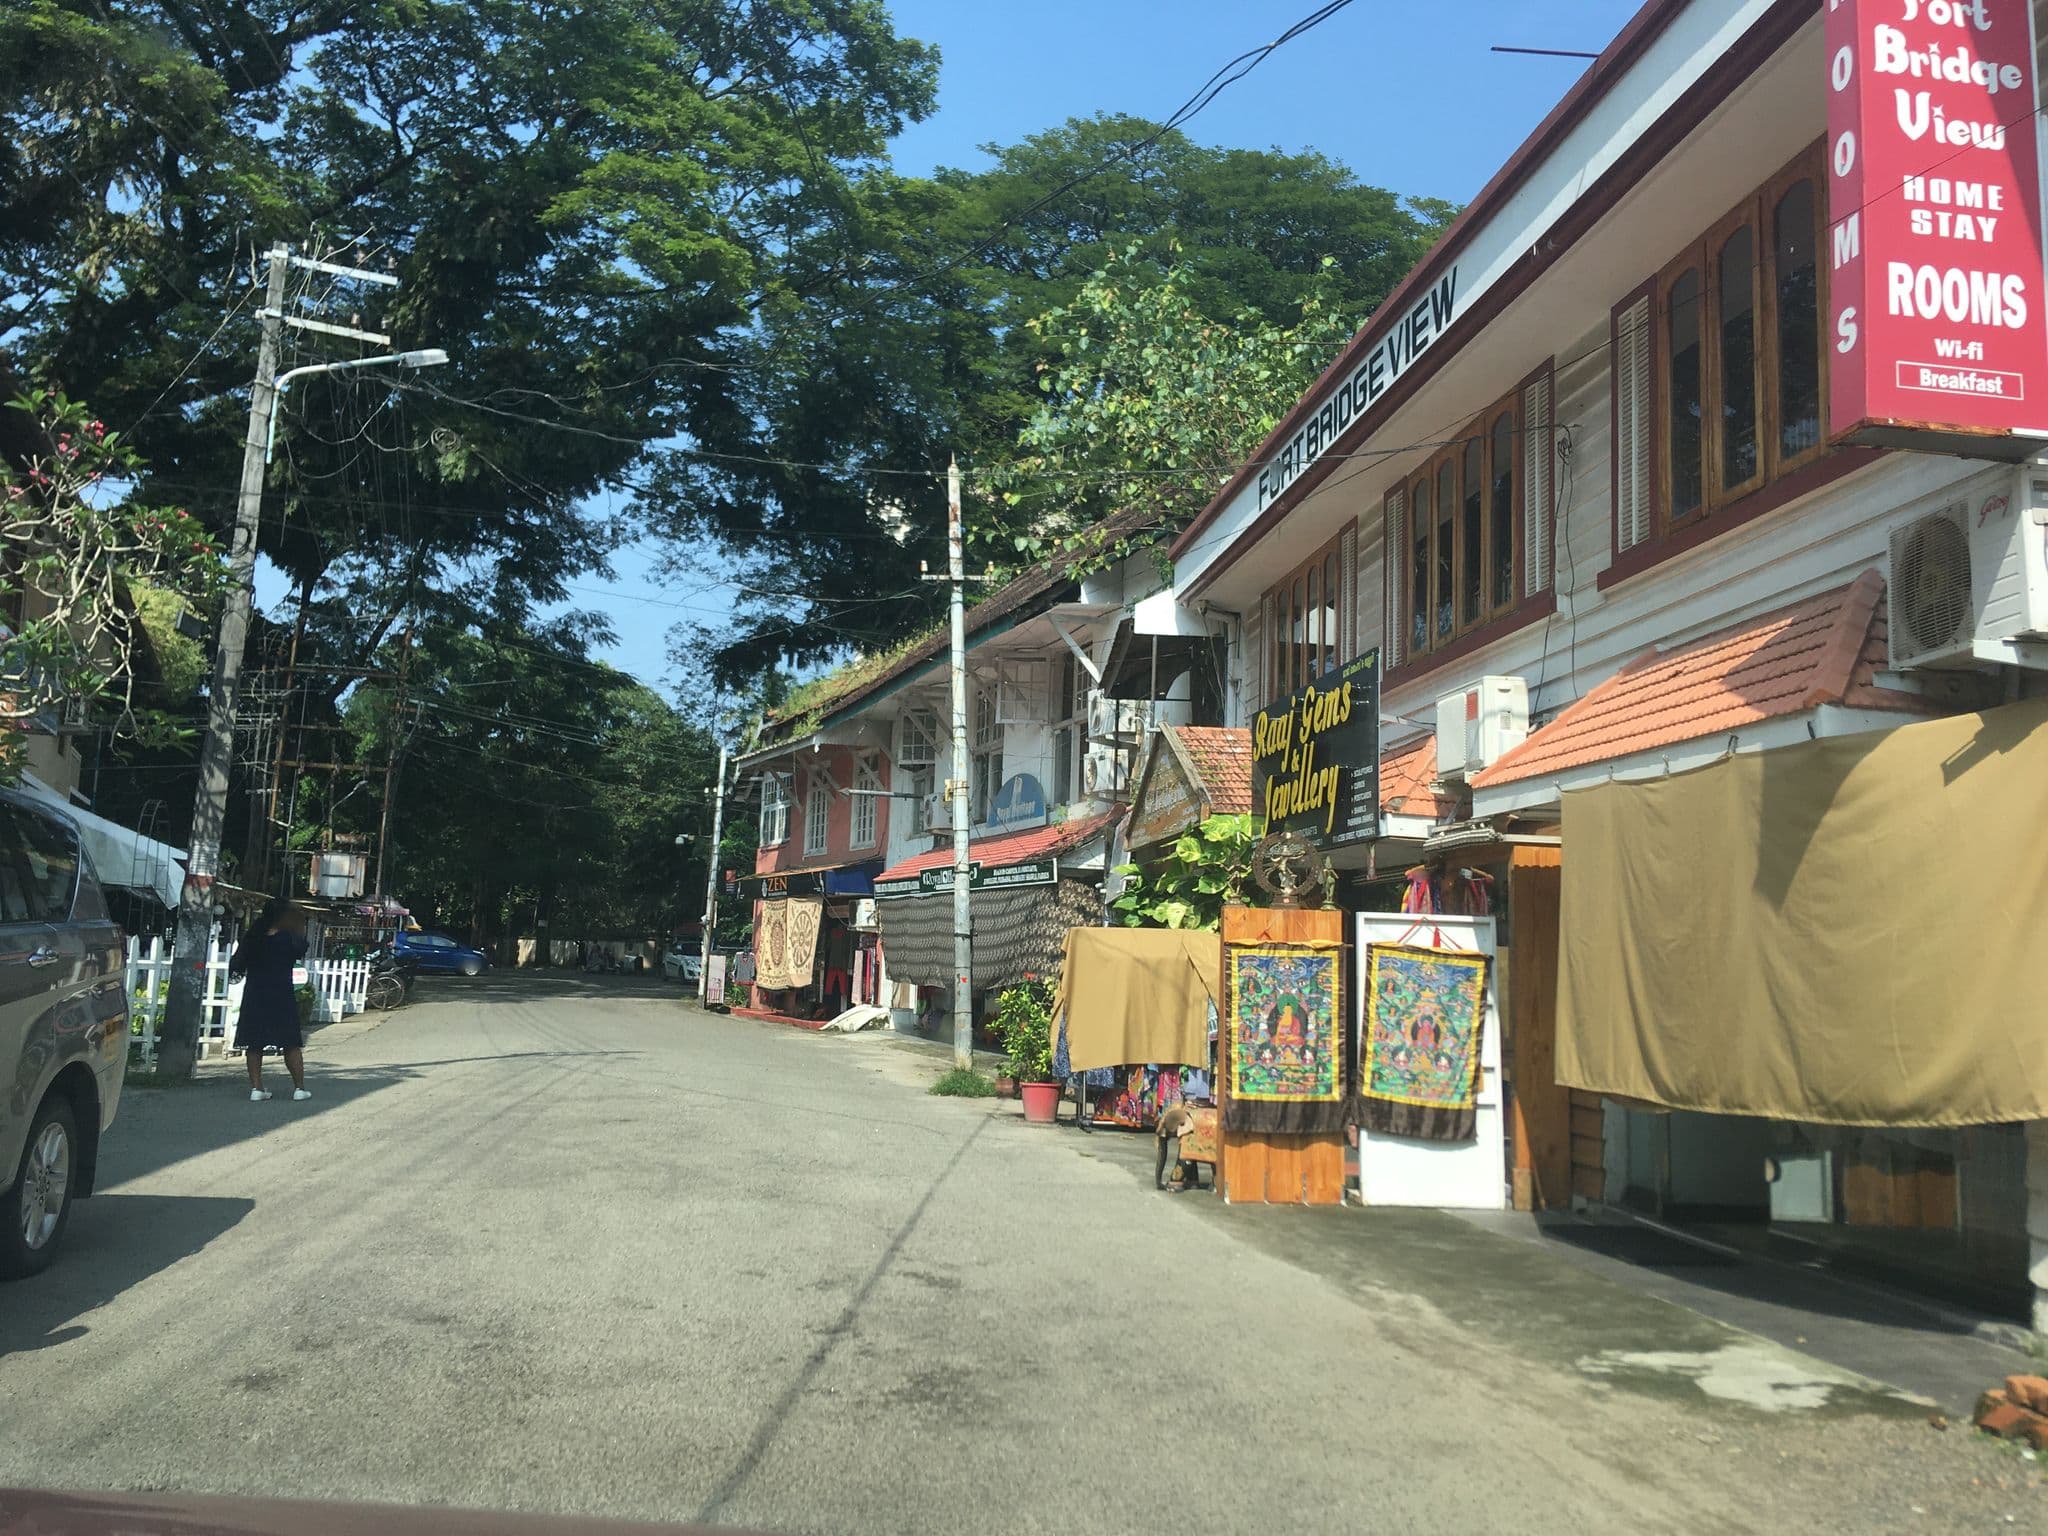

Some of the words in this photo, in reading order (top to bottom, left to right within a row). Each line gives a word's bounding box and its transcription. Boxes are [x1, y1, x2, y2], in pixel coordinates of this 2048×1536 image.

[1873, 23, 2023, 95] Bridge
[1894, 88, 2005, 151] View
[1830, 0, 1860, 355] OOMS
[1903, 175, 2004, 212] HOME
[1910, 208, 1998, 244] STAY
[1887, 261, 2027, 330] ROOMS
[1919, 367, 2004, 395] Breakfast
[1934, 337, 1984, 362] Wi-fi
[1258, 430, 1305, 512] FORT
[1306, 346, 1385, 460] BRIDGE
[1387, 265, 1458, 378] VIEW
[1253, 695, 1296, 773] Raaj
[1299, 680, 1352, 744] Gems
[1261, 740, 1340, 839] Jewellery
[1291, 748, 1300, 773] &
[767, 876, 788, 892] ZEN
